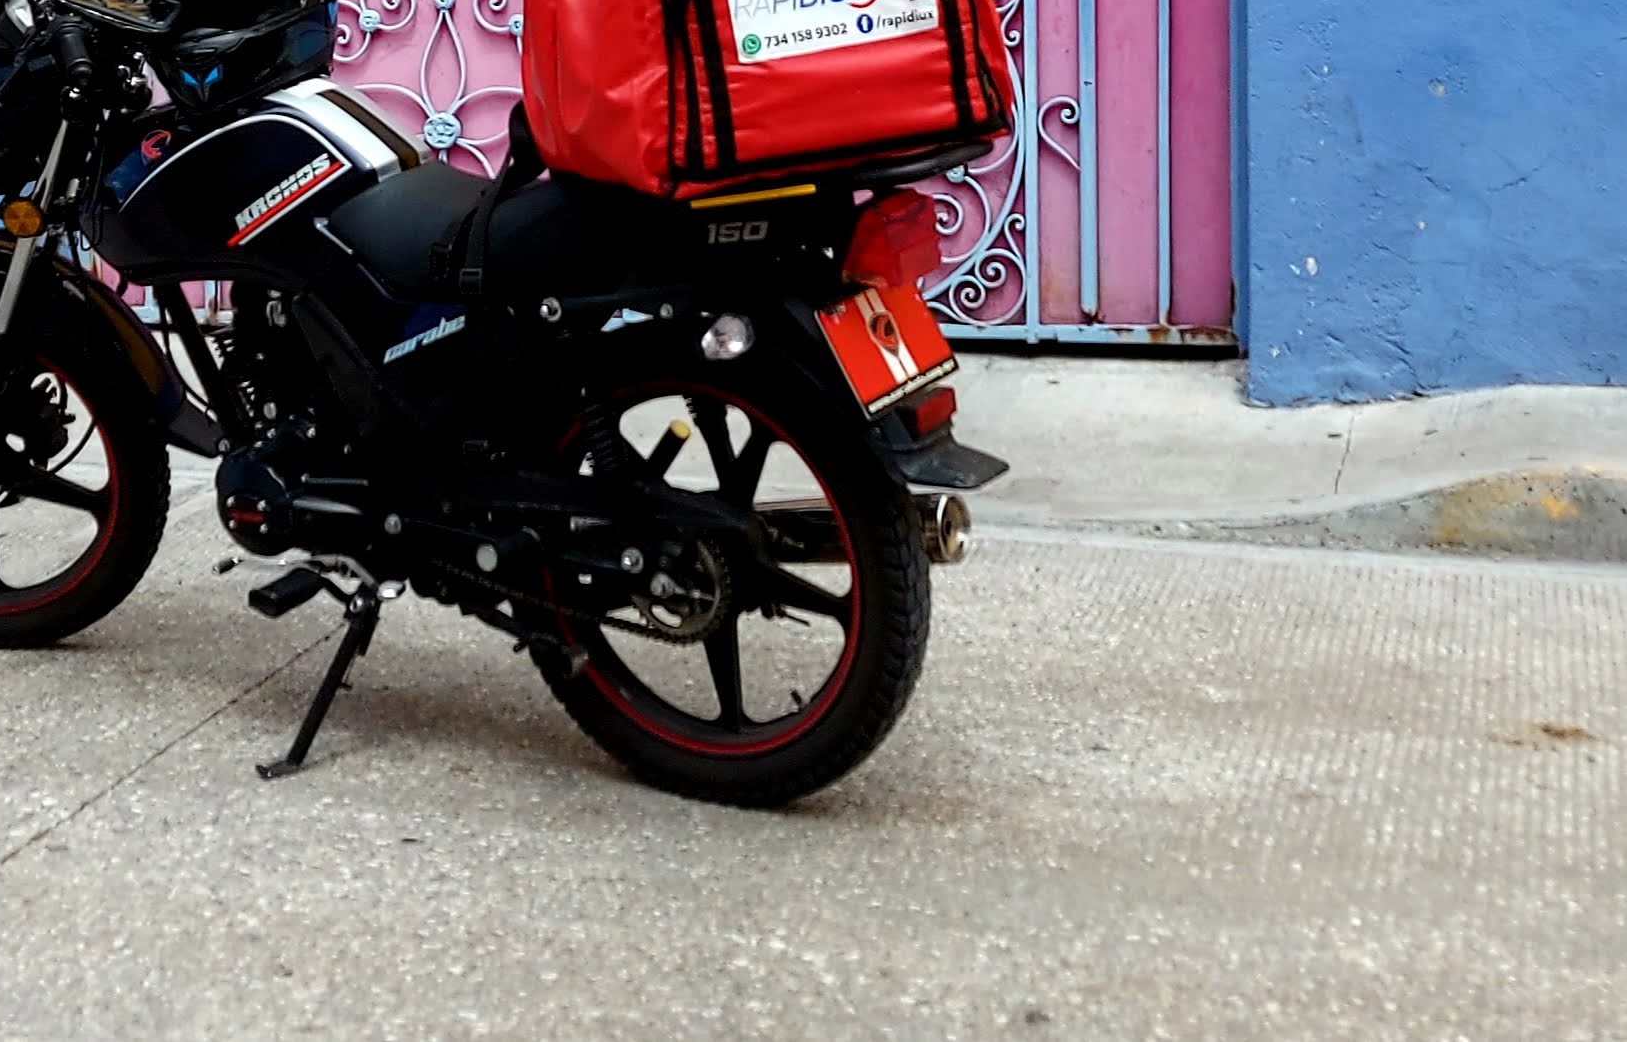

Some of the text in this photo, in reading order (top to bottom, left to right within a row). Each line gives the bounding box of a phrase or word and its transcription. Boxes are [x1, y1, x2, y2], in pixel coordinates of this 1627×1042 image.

[764, 35, 789, 49] 734
[791, 31, 813, 44] 158
[816, 22, 848, 39] 9302
[707, 221, 769, 245] 150
